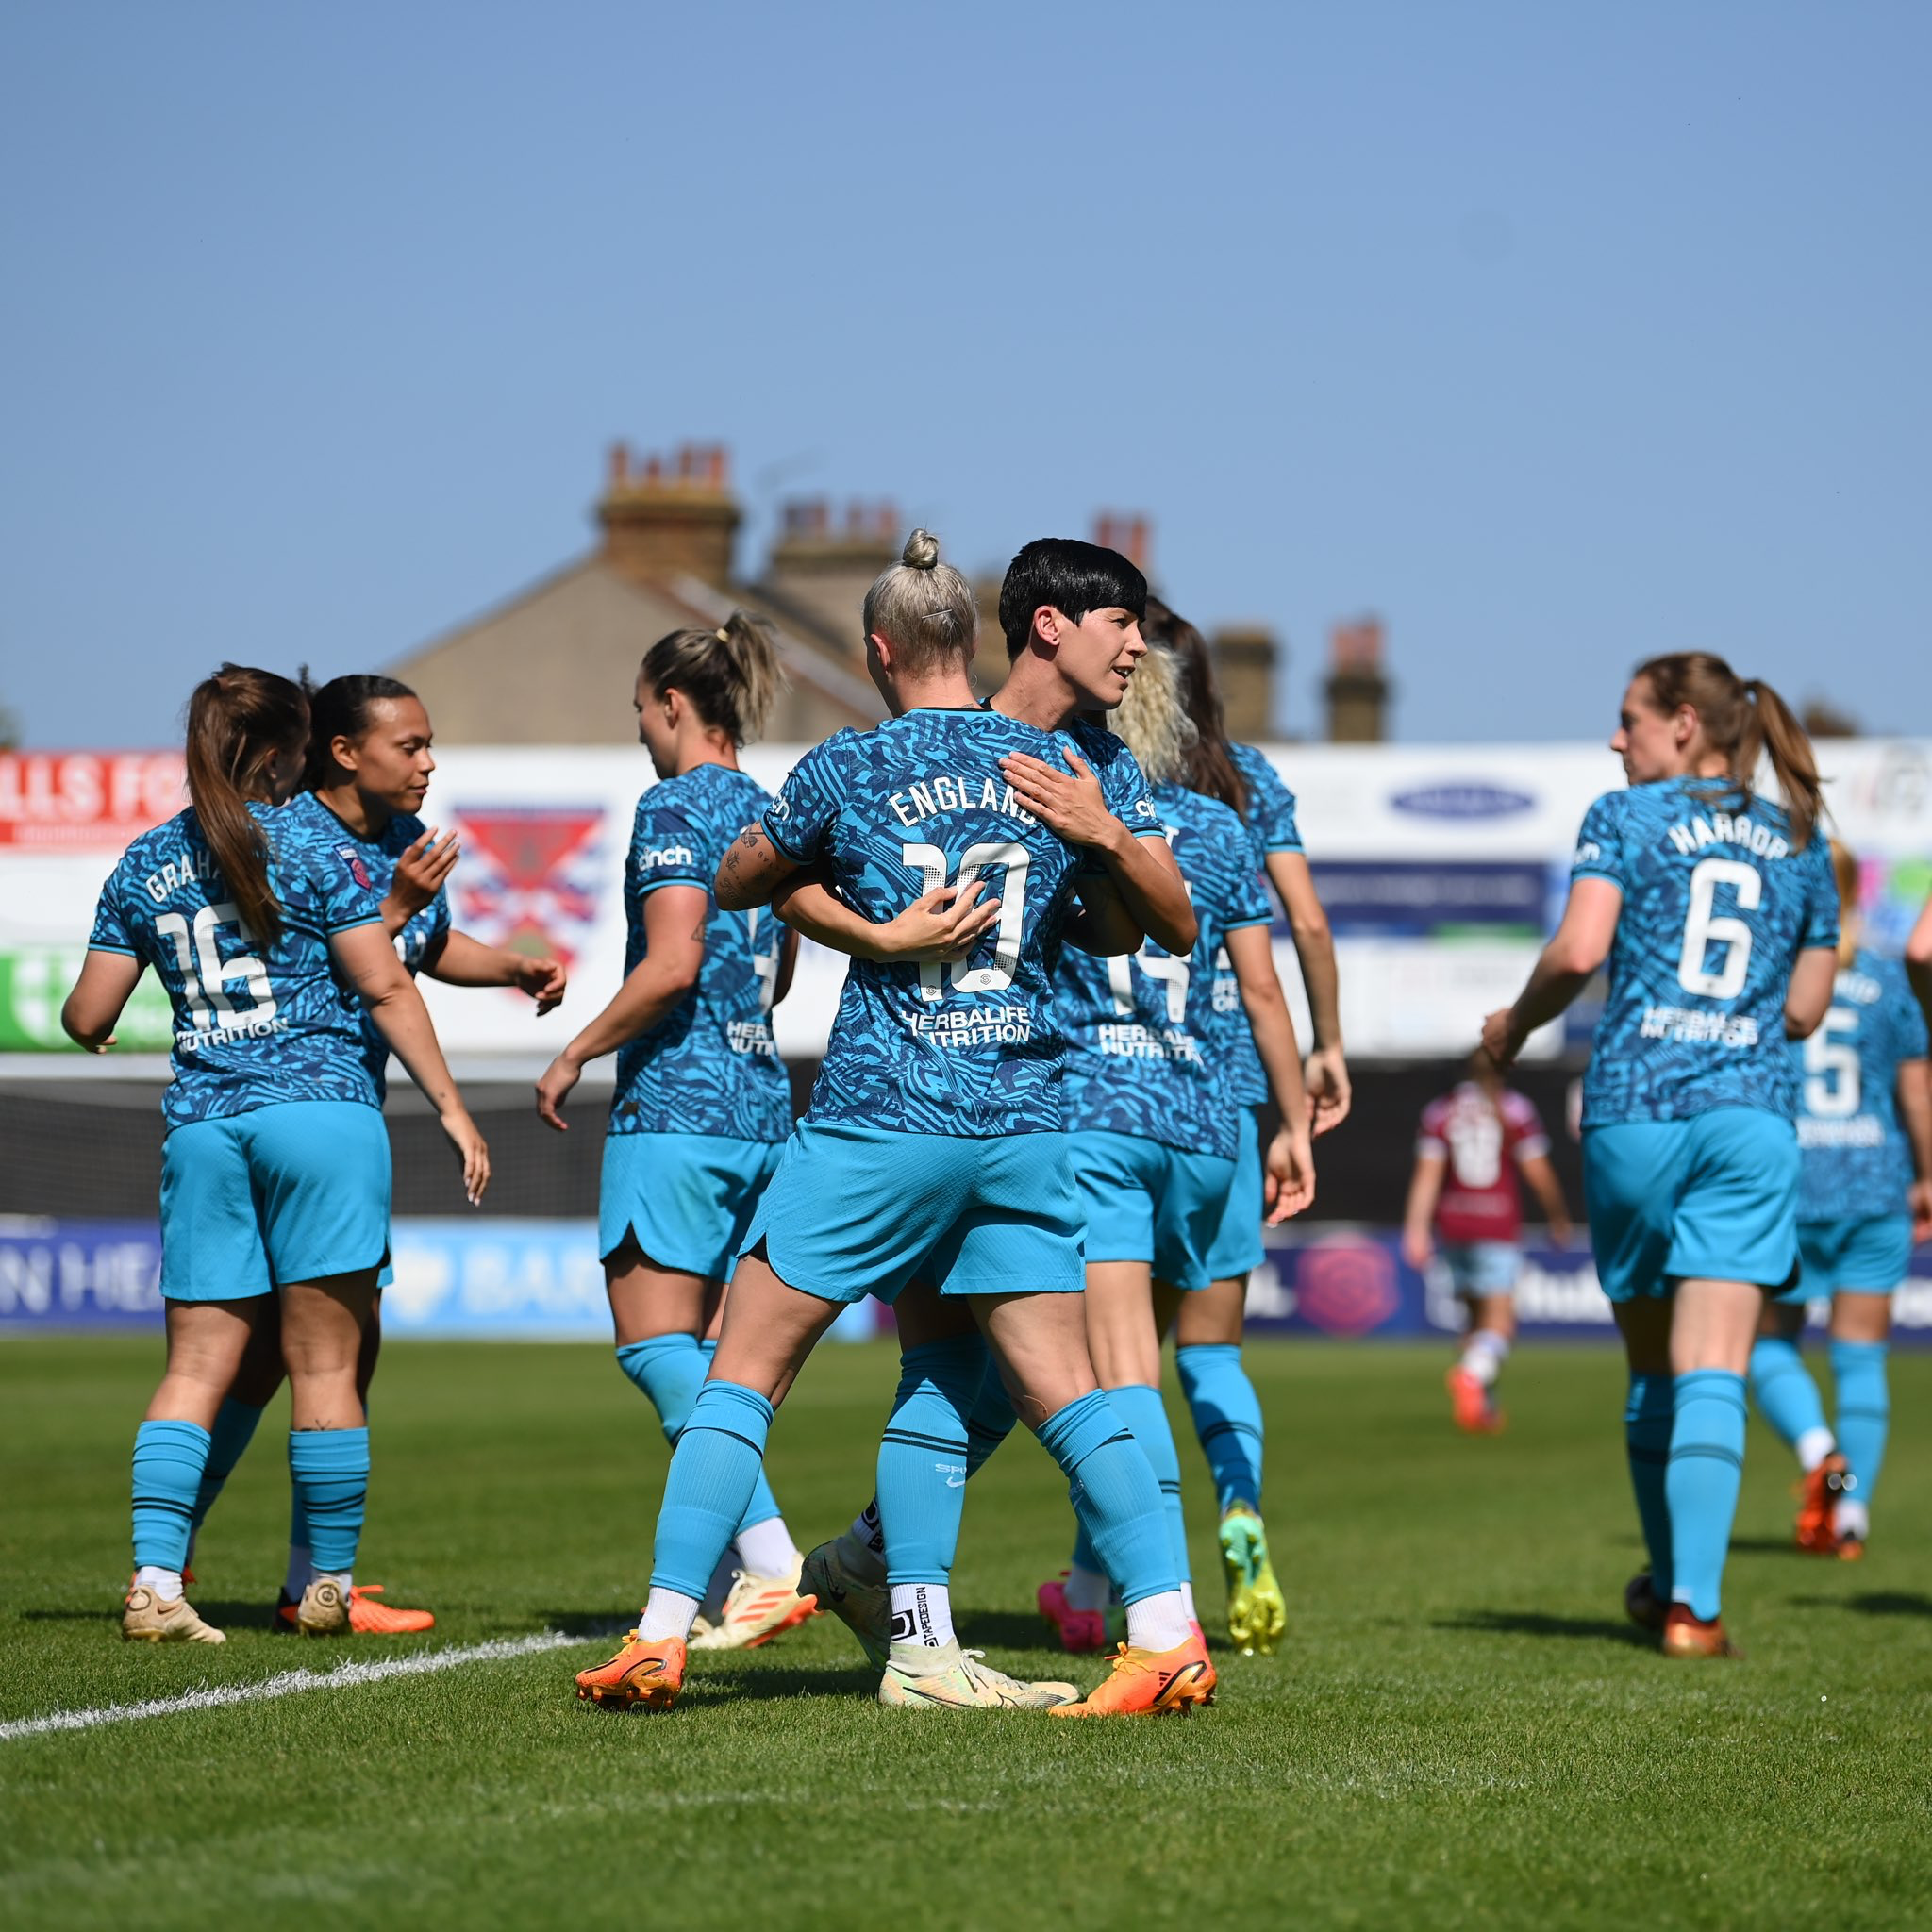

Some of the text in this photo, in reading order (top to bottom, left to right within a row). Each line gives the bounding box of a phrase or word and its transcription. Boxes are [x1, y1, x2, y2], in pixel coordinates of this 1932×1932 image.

[155, 903, 276, 1031] 16
[903, 843, 1030, 1002] 10
[1677, 857, 1762, 1000] 6
[902, 1006, 1030, 1037] HERBALIFE
[929, 1024, 1030, 1048] TRITION
[915, 1586, 934, 1640] TAPEDESIGN
